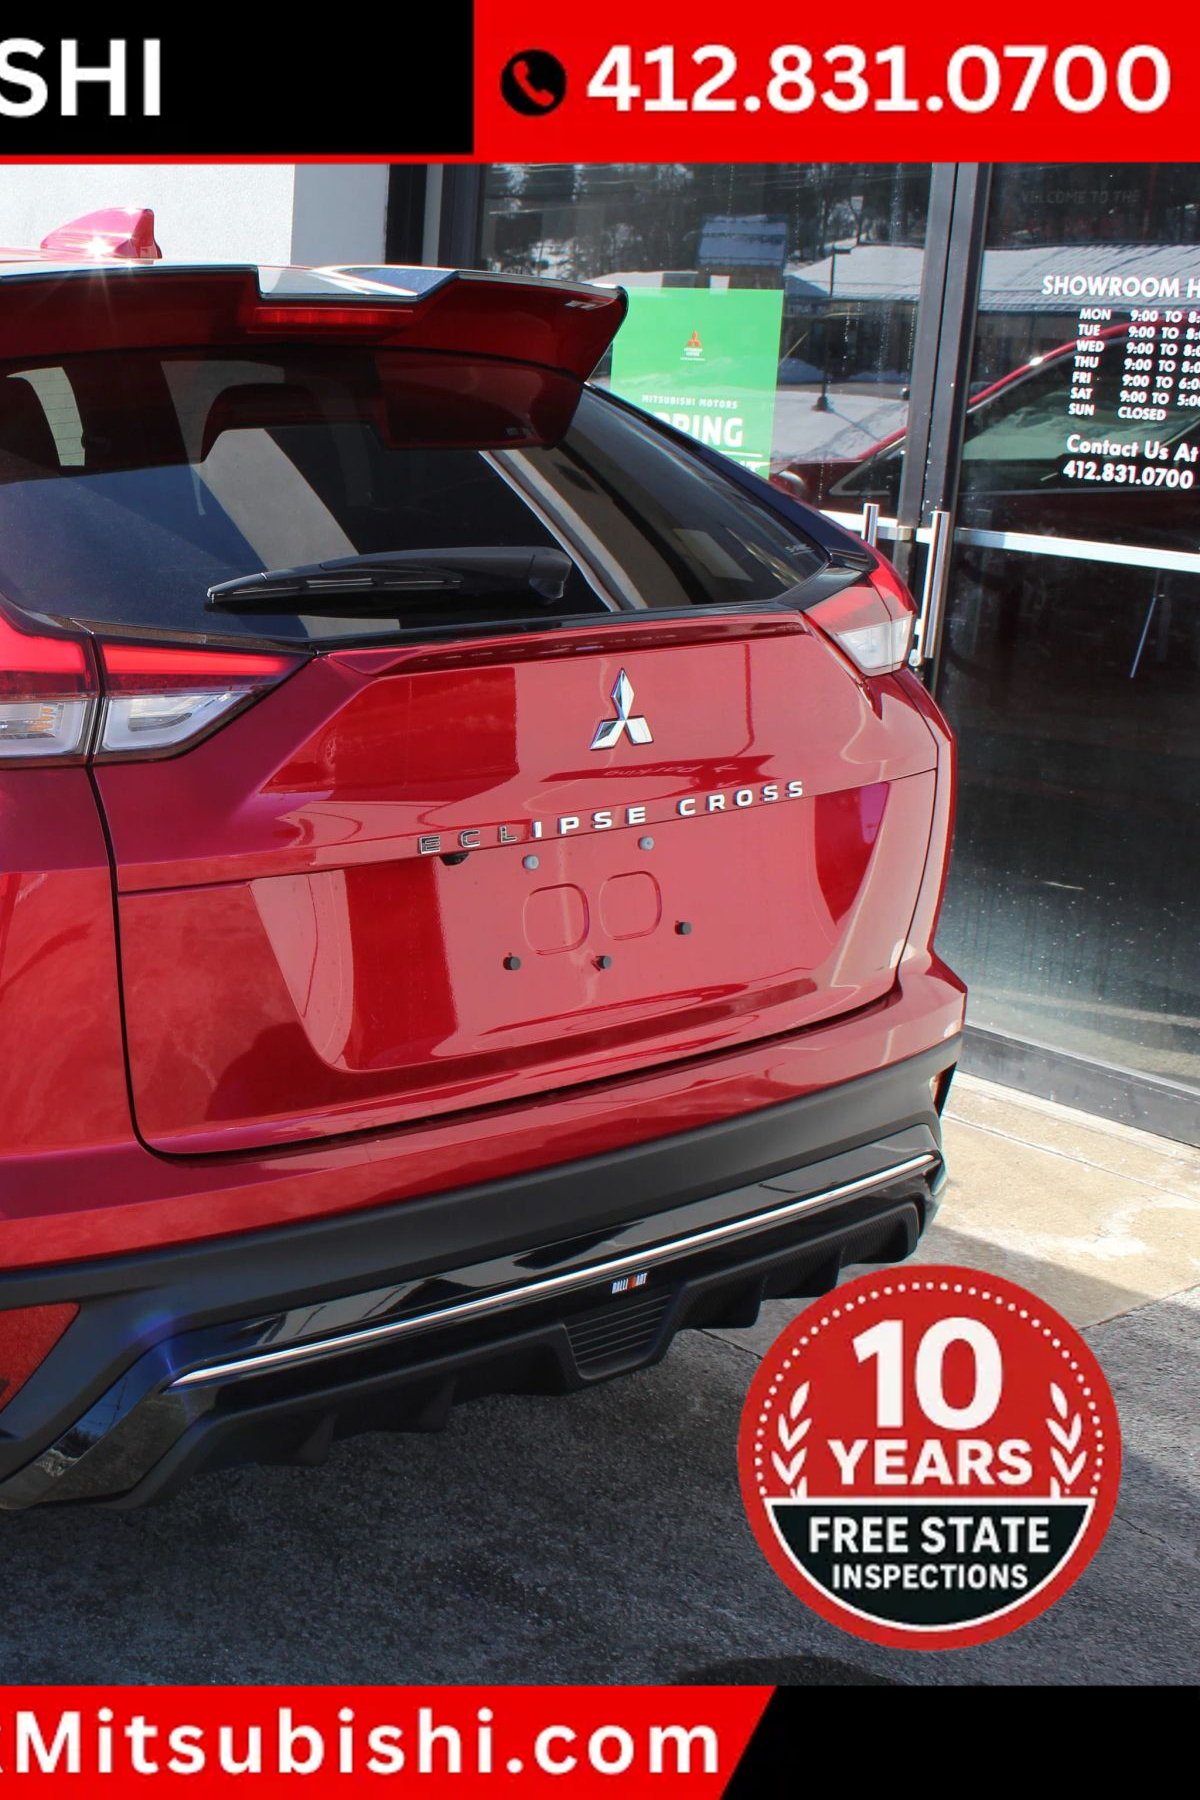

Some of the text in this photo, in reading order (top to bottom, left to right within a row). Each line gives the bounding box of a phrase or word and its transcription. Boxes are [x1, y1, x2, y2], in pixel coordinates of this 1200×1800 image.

[1042, 275, 1180, 298] SHOWROOM
[1079, 308, 1112, 321] MON
[1130, 310, 1159, 322] 9:00
[1164, 311, 1183, 323] TO
[1078, 323, 1101, 336] TUE
[1128, 326, 1155, 338] 9:00
[1161, 327, 1180, 339] TO
[1076, 340, 1105, 353] WED
[1126, 342, 1154, 355] 9:00
[1160, 343, 1178, 356] TO
[1074, 356, 1099, 369] THU
[1124, 358, 1152, 371] 9:00
[1158, 360, 1176, 372] TO
[1072, 371, 1200, 390] FRI 9:00 TO 6:0
[642, 394, 738, 409] MITSUBISHI MOTORS
[1070, 387, 1093, 400] SAT
[1120, 390, 1147, 403] 9:00
[1152, 392, 1170, 405] TO
[1068, 403, 1167, 421] SUN CLOSED
[1066, 434, 1199, 462] Contact Us At
[1063, 460, 1194, 490] 412.831.0700
[419, 781, 803, 855] ECLIPSE CROSS
